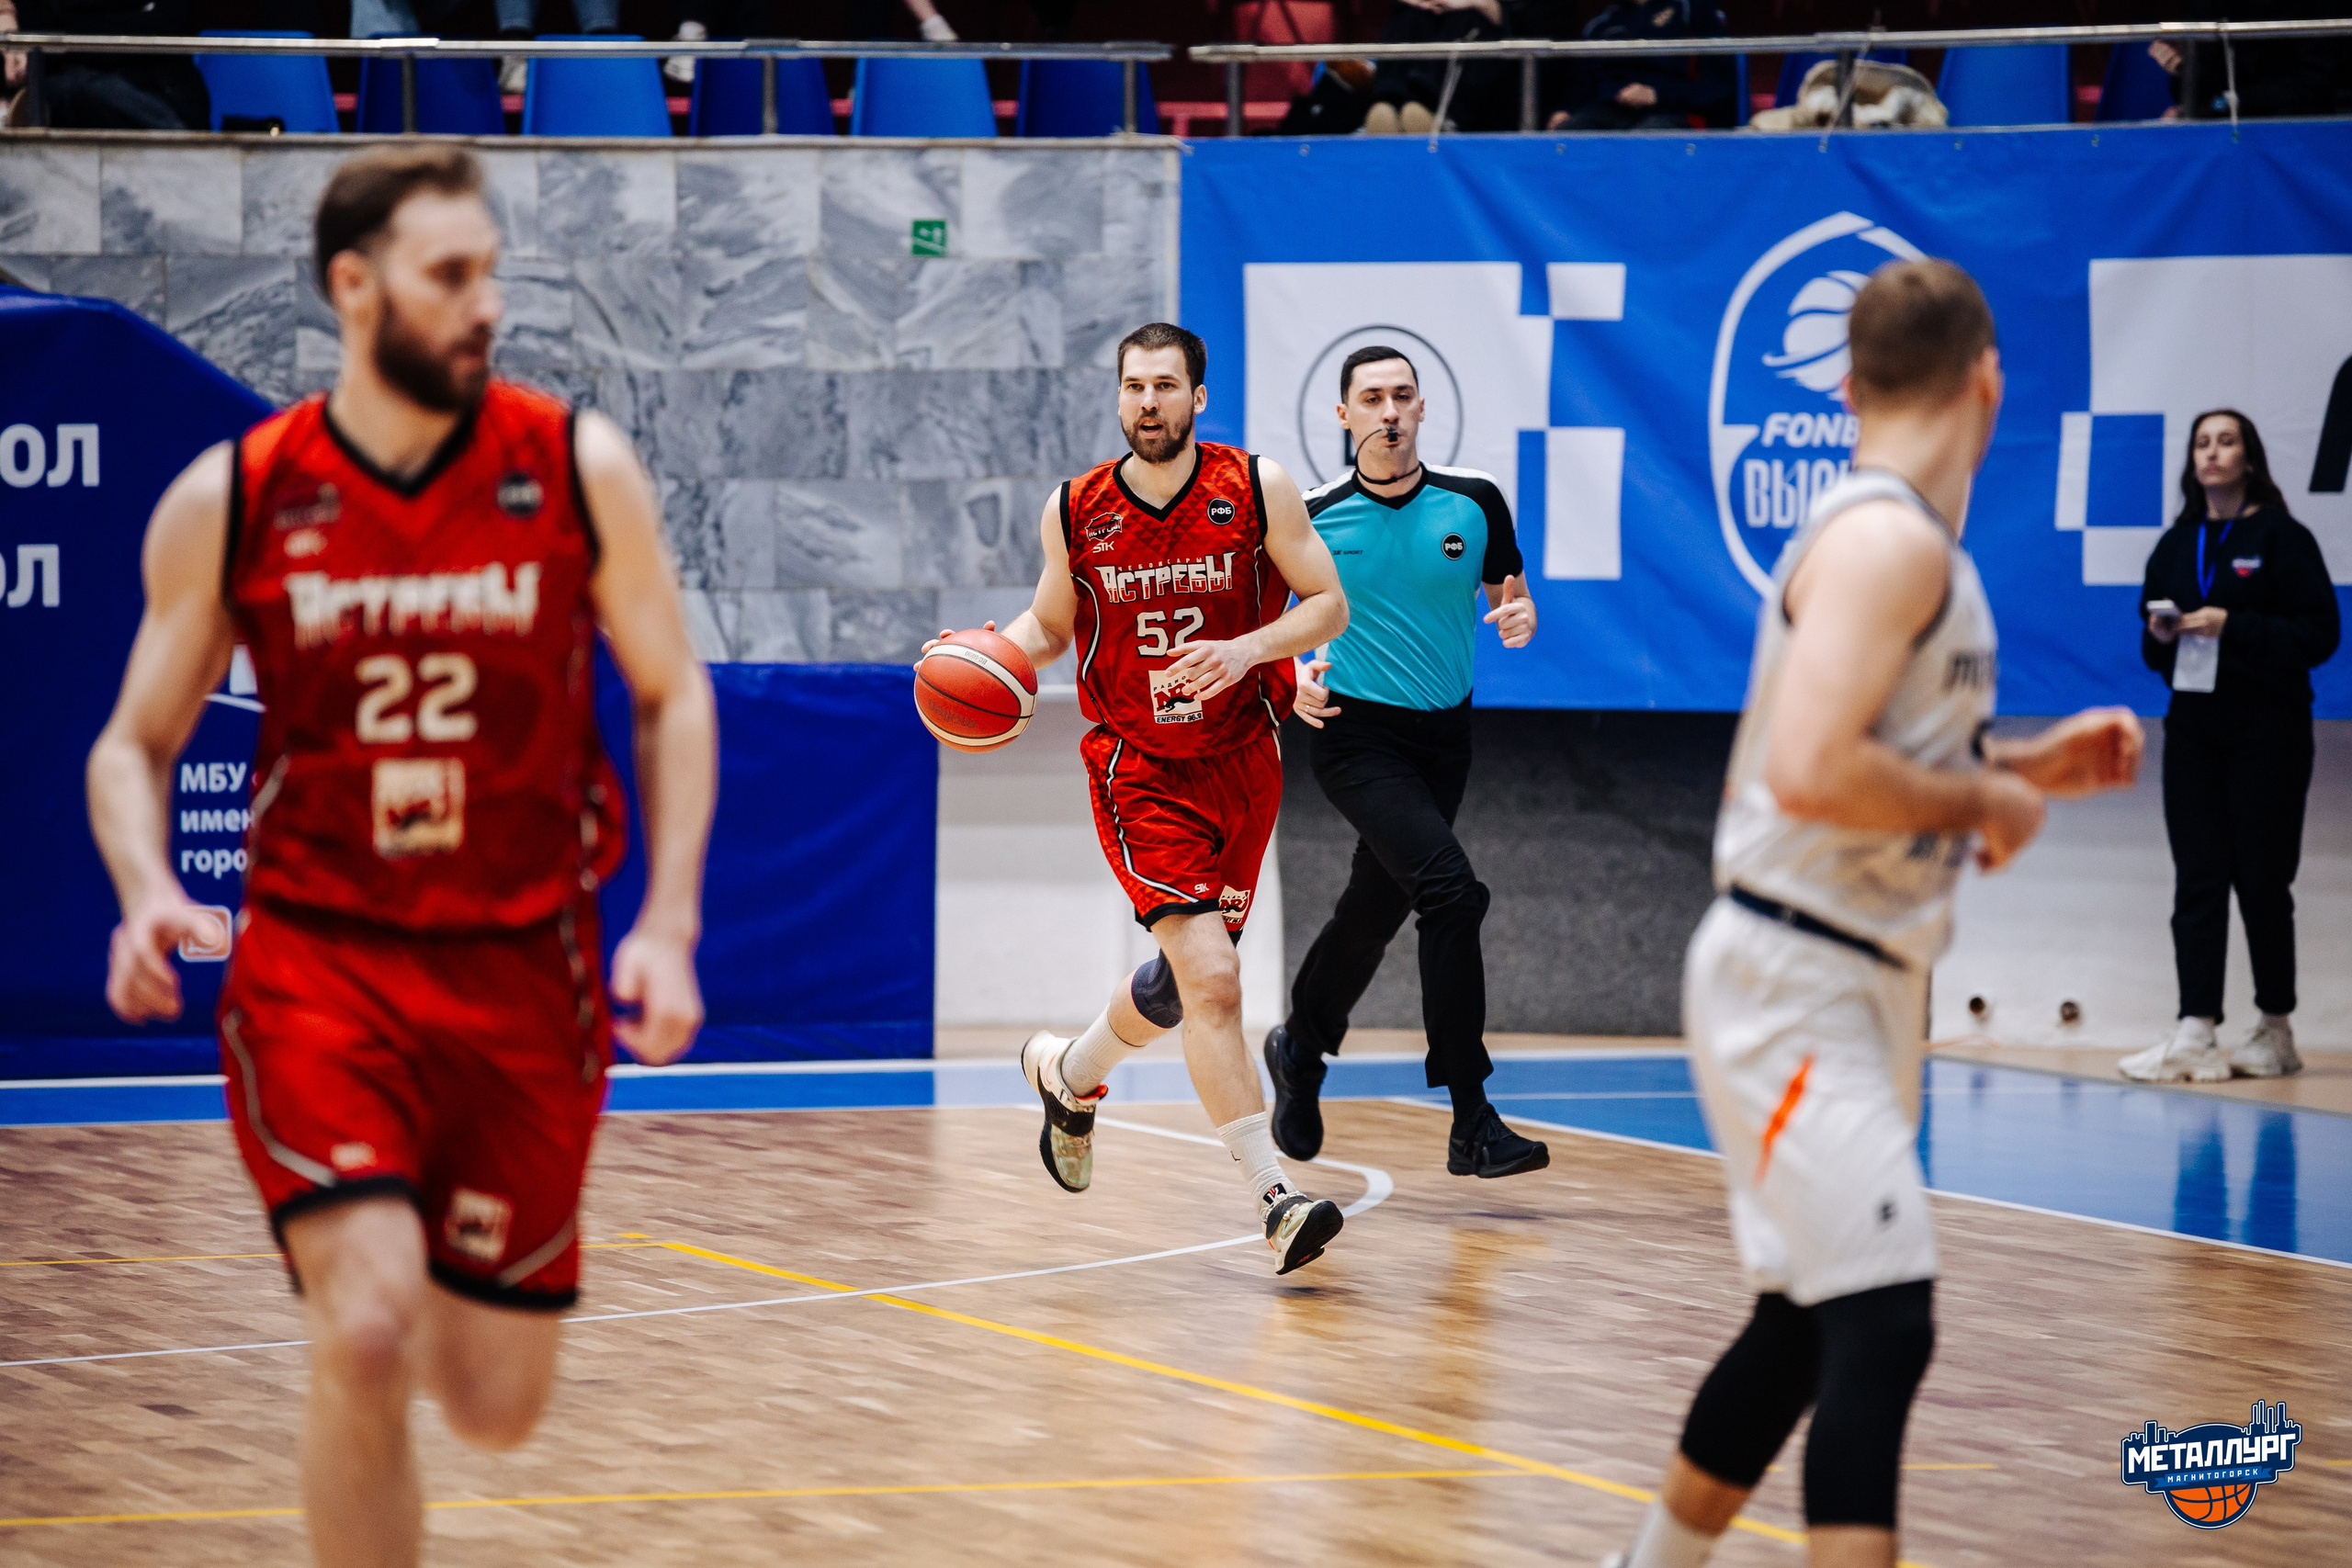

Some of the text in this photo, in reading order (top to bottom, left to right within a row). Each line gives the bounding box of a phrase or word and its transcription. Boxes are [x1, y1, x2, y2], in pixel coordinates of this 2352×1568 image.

[1211, 506, 1232, 515] РФБ
[1092, 541, 1114, 553] STK
[1444, 542, 1464, 551] РФБ
[0, 544, 60, 608] Л
[1093, 551, 1237, 604] ЯСТРЕБЫ
[1117, 558, 1203, 571] ЧЕБОКСАРЫ
[1136, 605, 1204, 657] 52
[356, 652, 478, 745] 22
[1153, 675, 1186, 692] РАДИО
[180, 761, 247, 794] МБУ
[180, 848, 248, 880] горо
